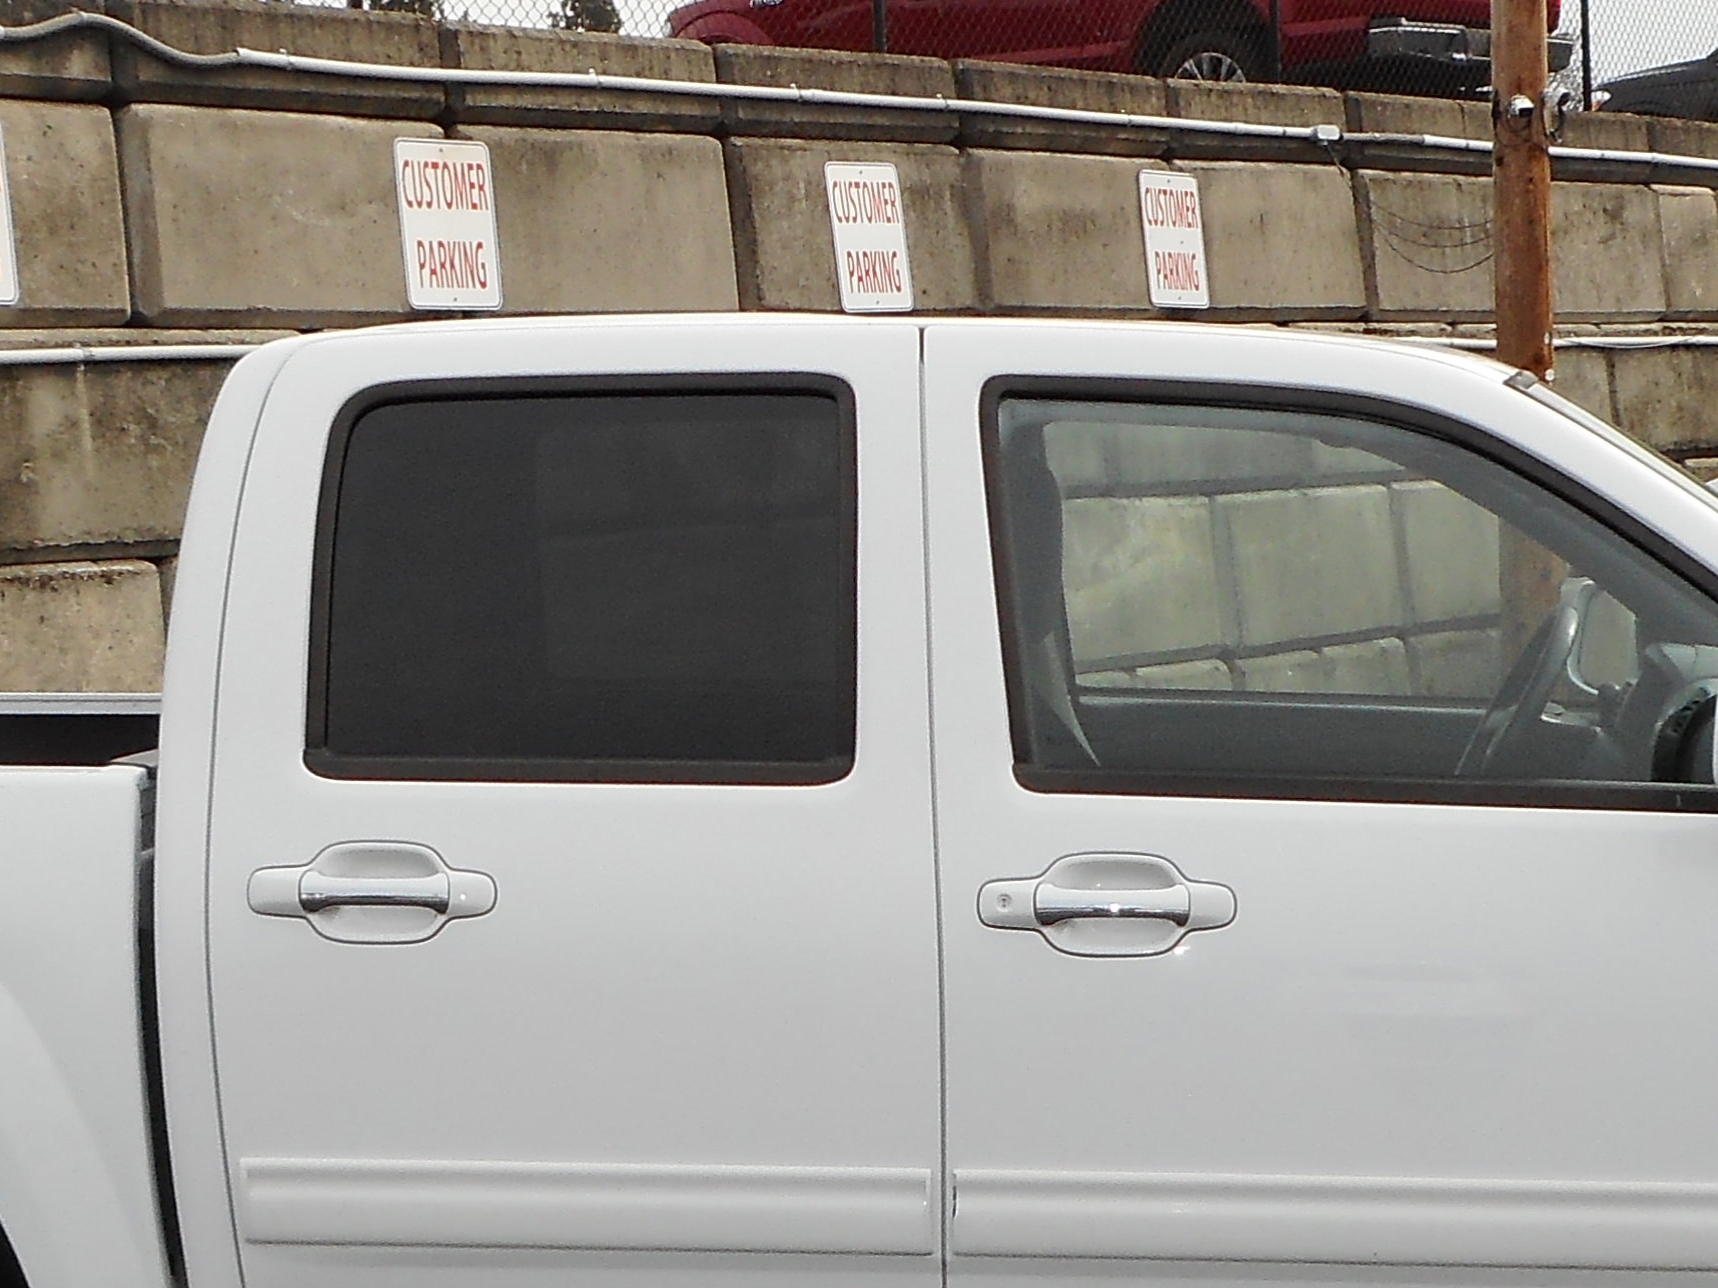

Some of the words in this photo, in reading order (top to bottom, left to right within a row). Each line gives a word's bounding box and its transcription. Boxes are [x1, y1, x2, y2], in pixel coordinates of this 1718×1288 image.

[402, 159, 489, 211] CUSTOMER
[833, 180, 900, 224] CUSTOMER
[1145, 187, 1199, 229] CUSTOMER
[416, 239, 488, 290] PARKING
[846, 250, 902, 294] PARKING
[1155, 251, 1200, 291] PARKING
